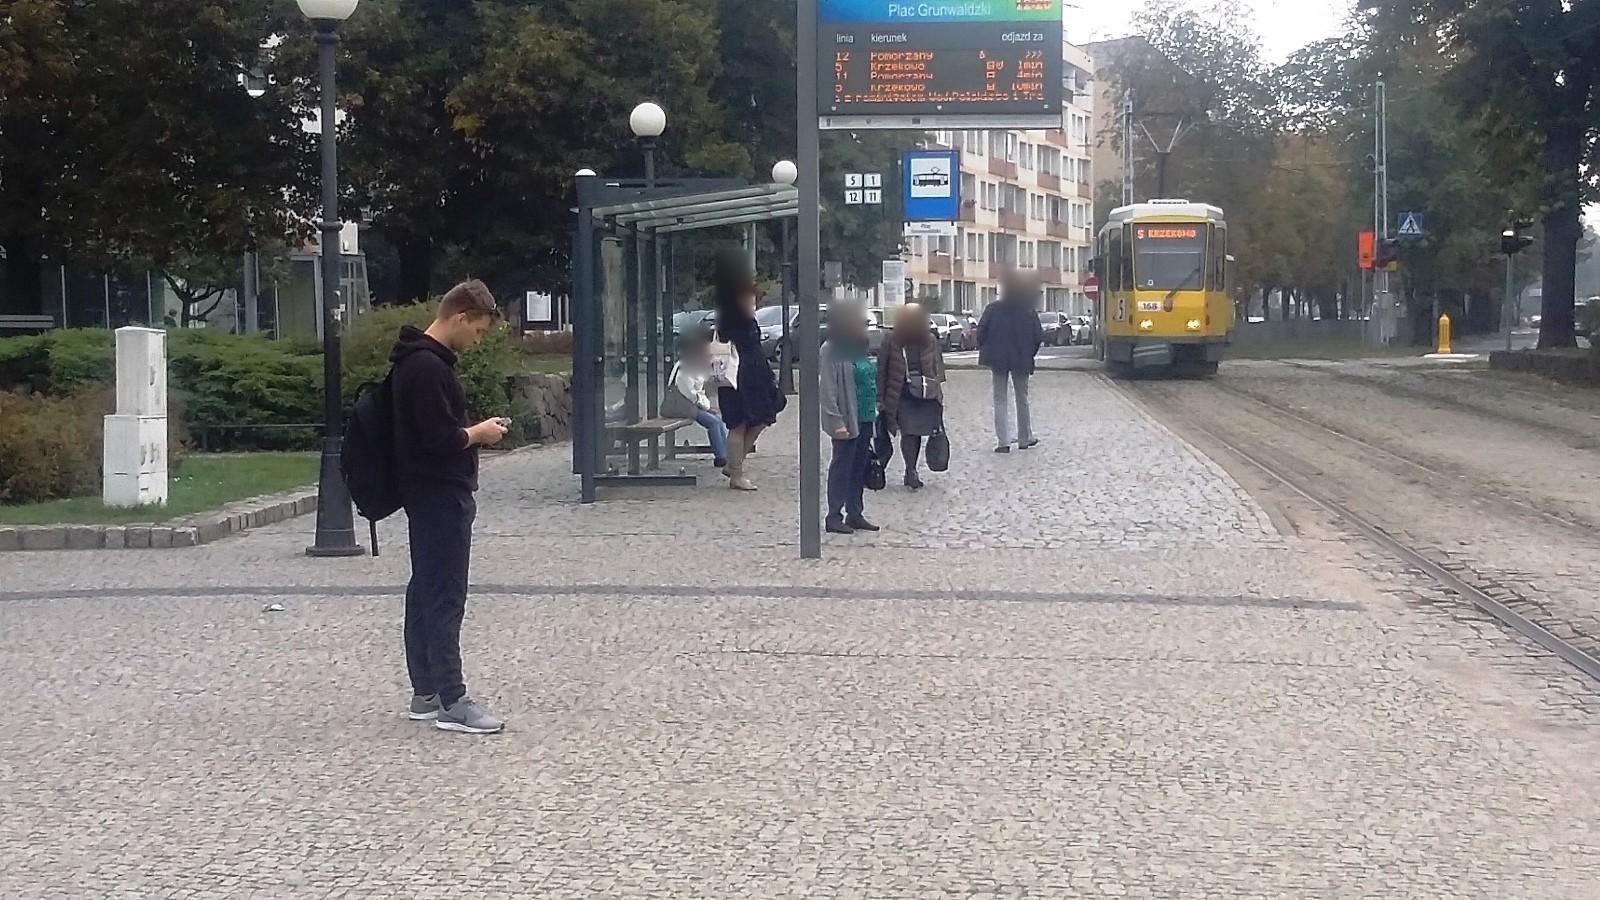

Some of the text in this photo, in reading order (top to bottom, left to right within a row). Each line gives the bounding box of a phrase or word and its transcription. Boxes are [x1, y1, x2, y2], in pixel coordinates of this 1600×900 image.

[888, 2, 991, 17] Plac Grunwaldzki
[836, 34, 854, 43] linia
[871, 33, 908, 43] kierunek
[1001, 32, 1044, 44] odjazd za
[836, 51, 850, 61] 12
[870, 51, 934, 61] Pomorzany
[851, 175, 856, 186] 5
[849, 192, 858, 202] 12
[869, 192, 877, 201] 11
[1143, 301, 1158, 311] 168
